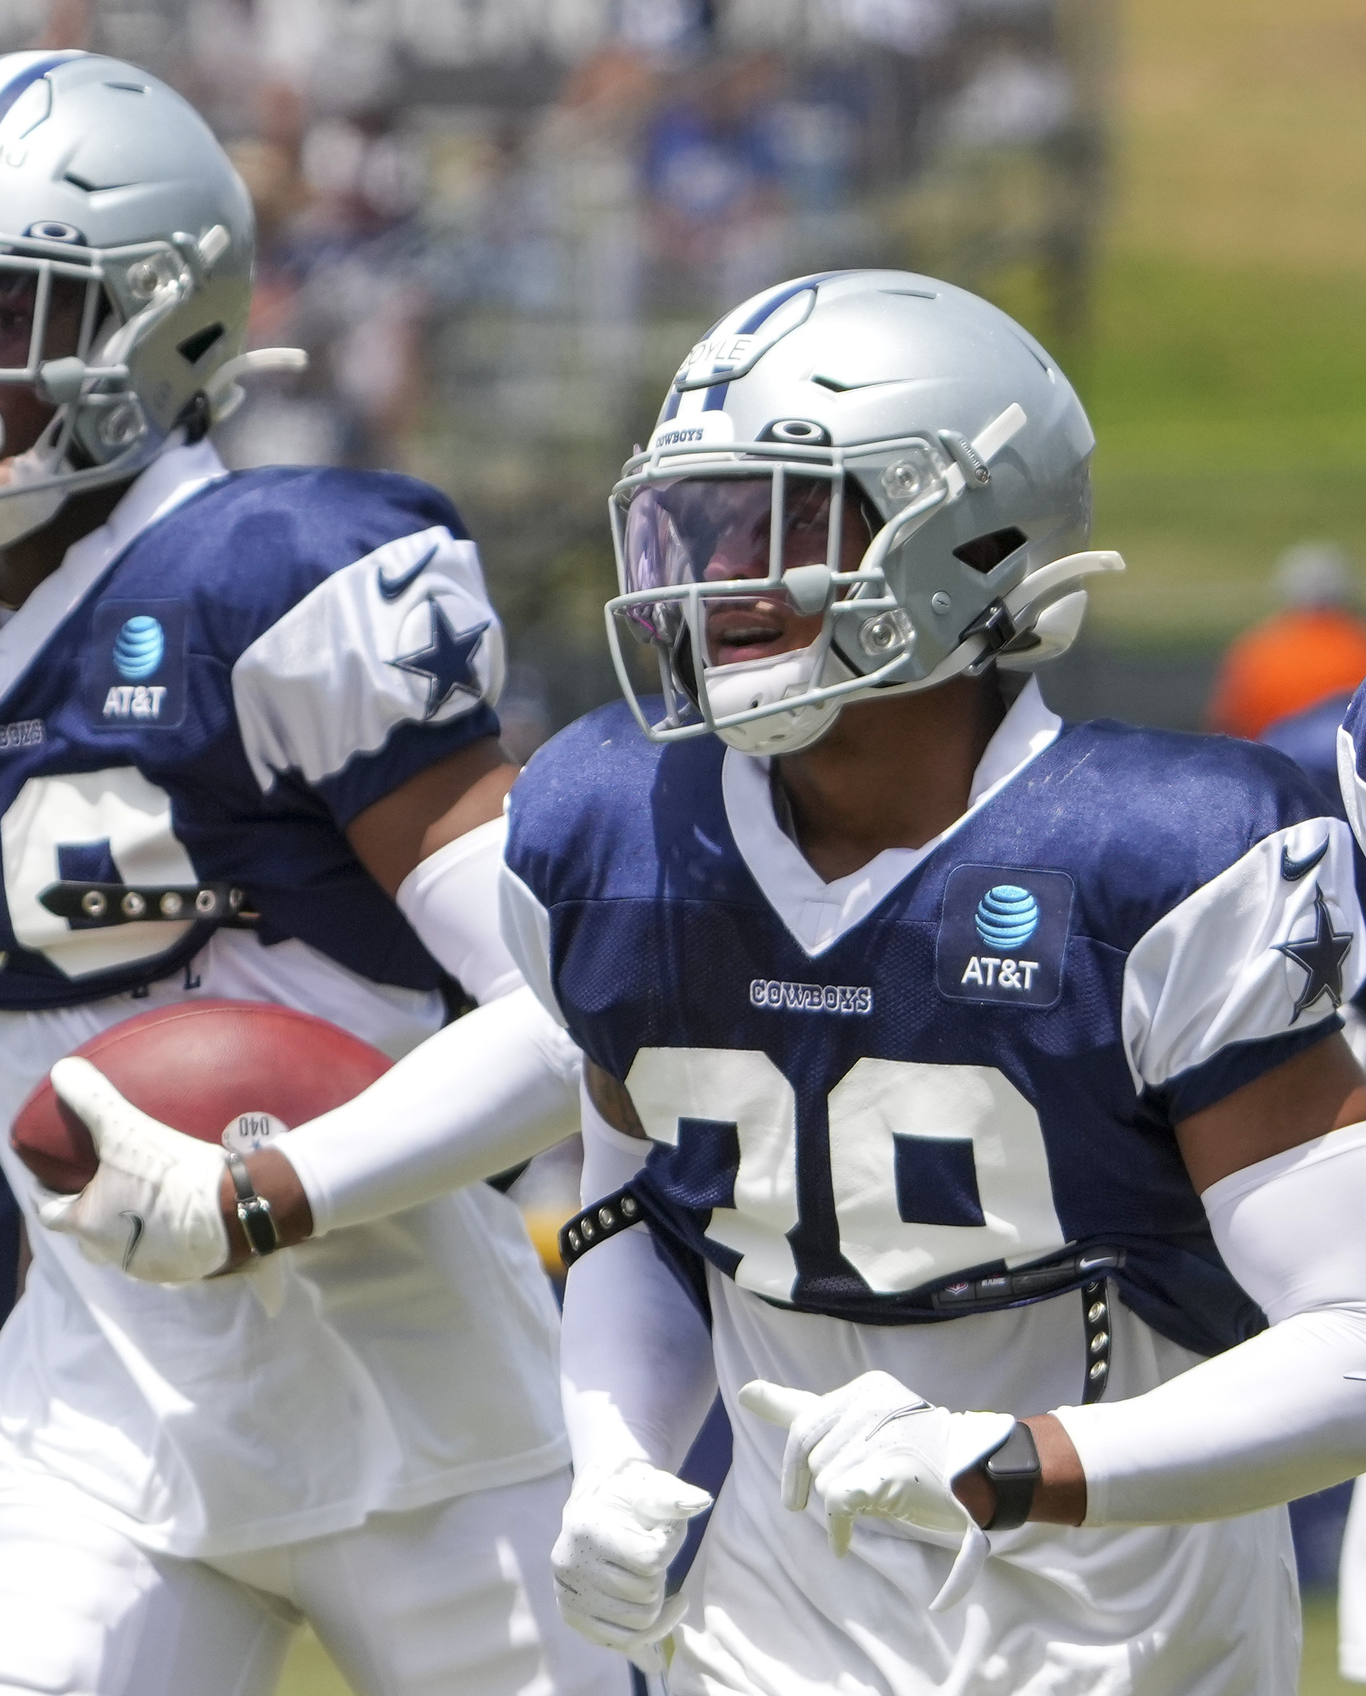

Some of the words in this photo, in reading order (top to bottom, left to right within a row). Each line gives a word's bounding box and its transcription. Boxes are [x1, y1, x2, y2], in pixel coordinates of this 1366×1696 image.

[103, 686, 167, 719] AT&T
[961, 955, 1040, 993] AT&T
[748, 977, 873, 1014] COWBOYS
[239, 1116, 270, 1137] 040
